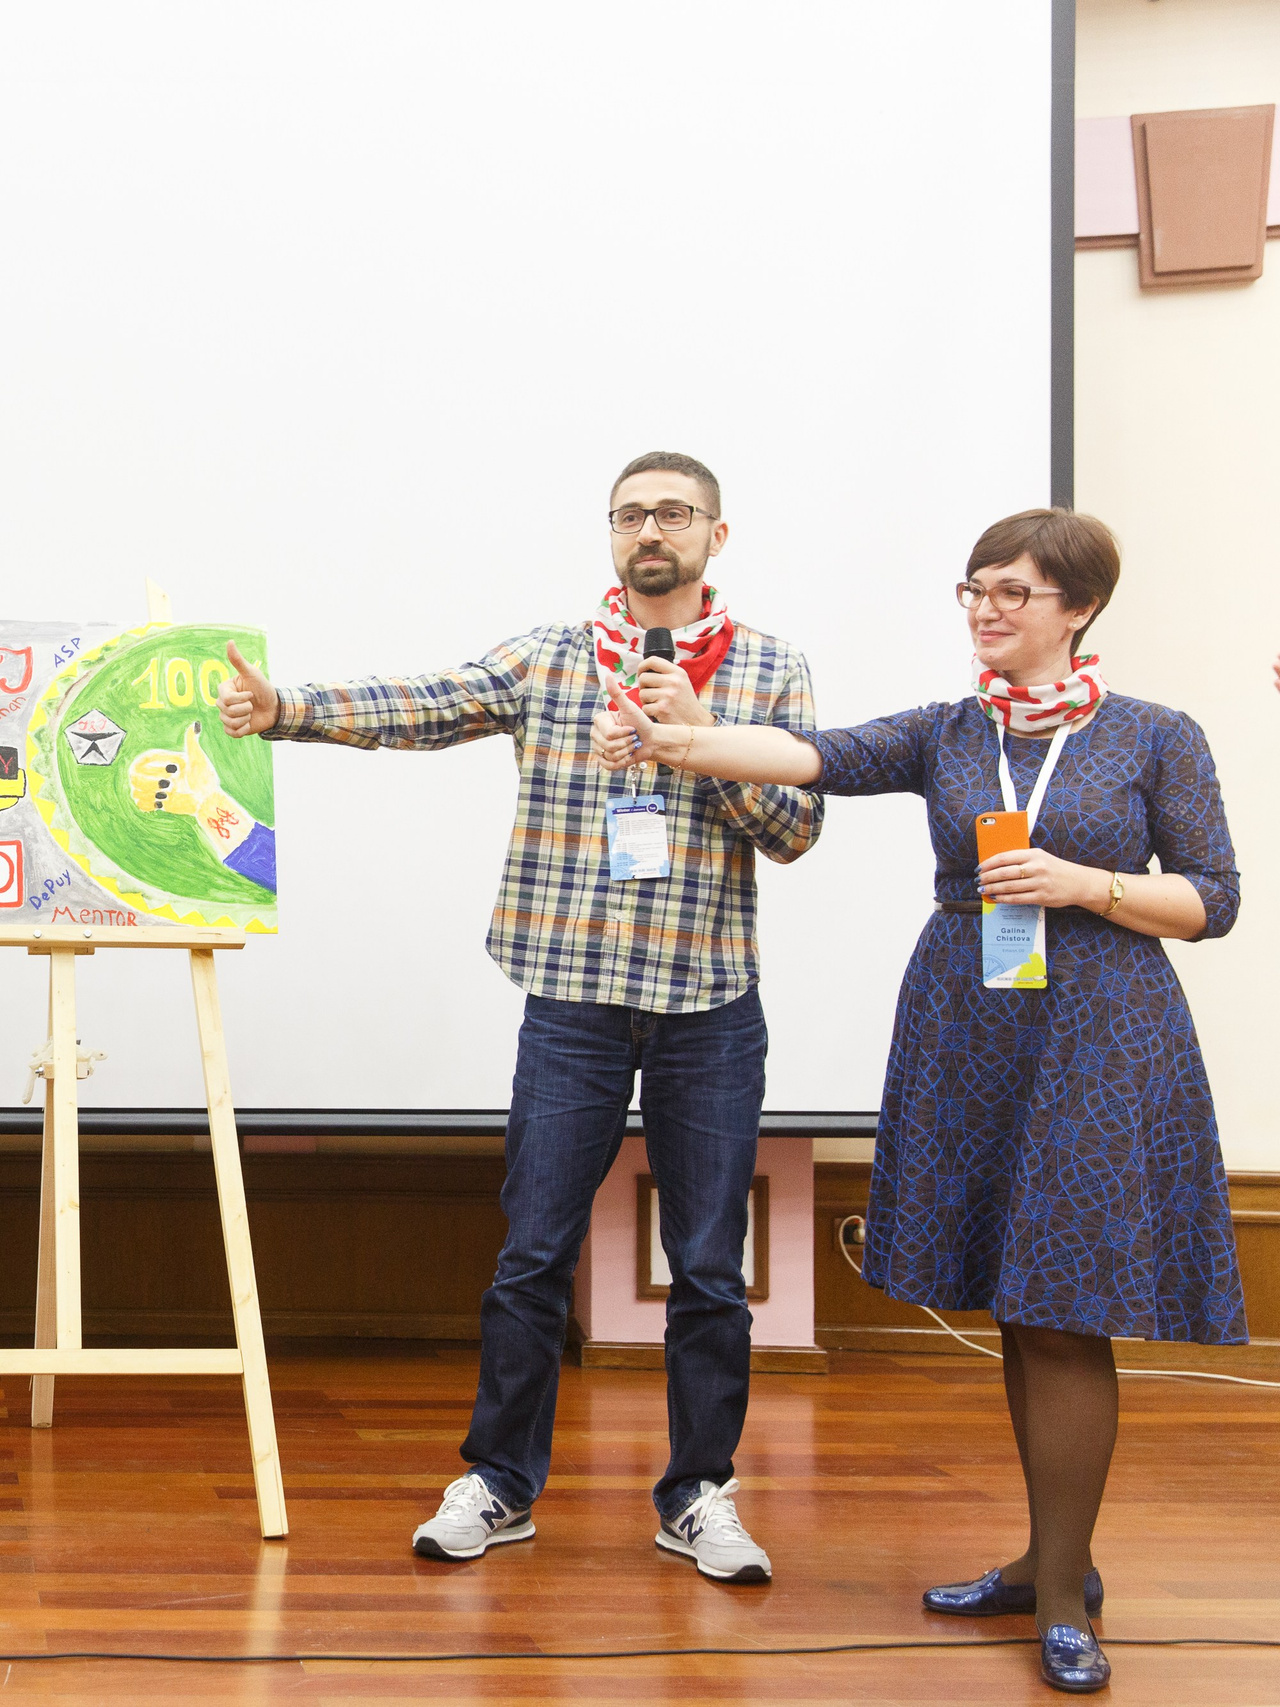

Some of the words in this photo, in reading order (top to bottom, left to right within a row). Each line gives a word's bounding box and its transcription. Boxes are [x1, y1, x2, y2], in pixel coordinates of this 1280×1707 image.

[54, 637, 81, 668] ASP
[131, 657, 262, 710] 100
[479, 1499, 508, 1531] N
